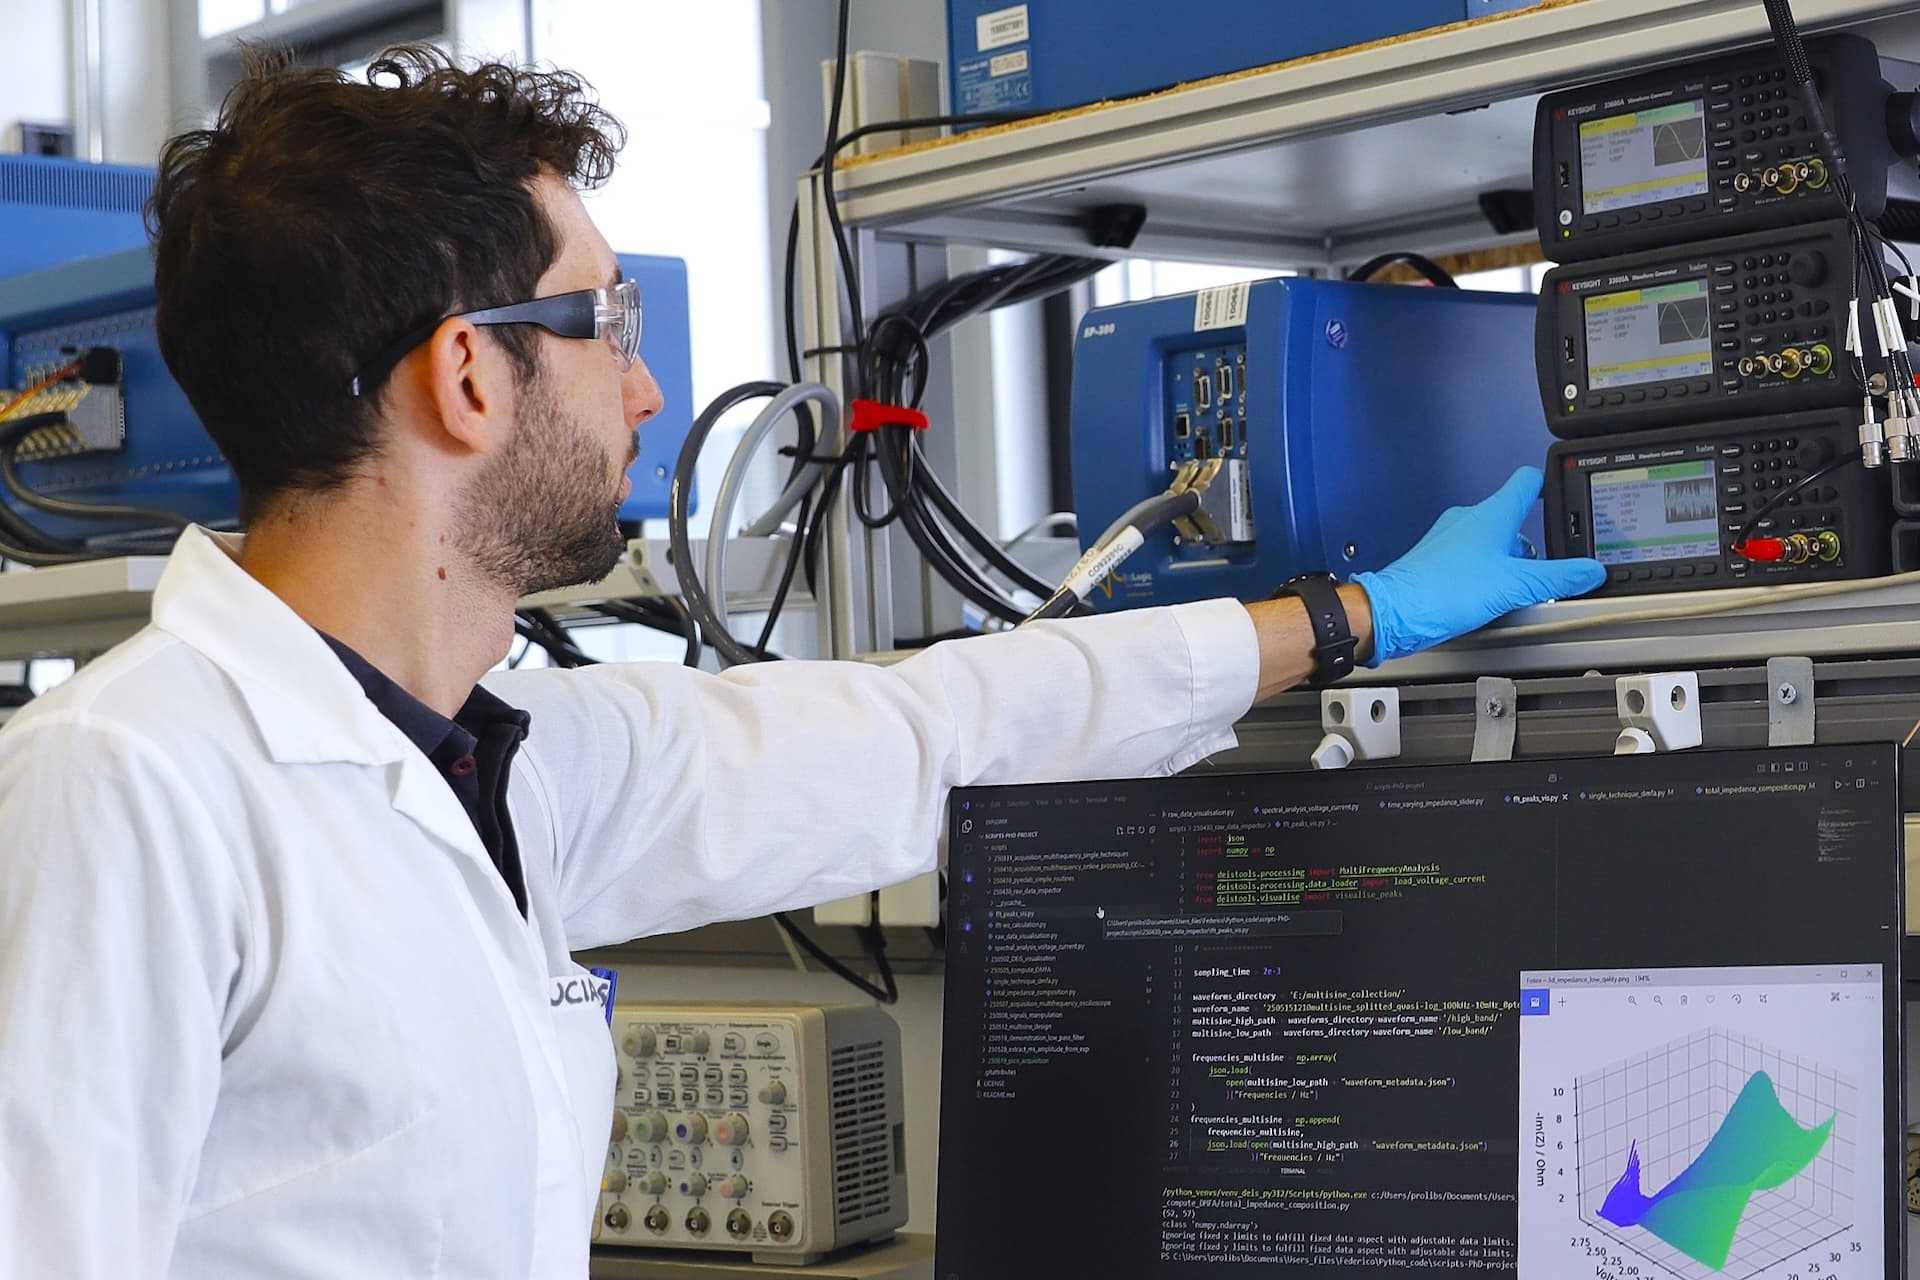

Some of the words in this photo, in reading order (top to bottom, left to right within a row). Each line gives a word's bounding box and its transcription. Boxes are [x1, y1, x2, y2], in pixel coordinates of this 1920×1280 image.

[1568, 104, 1596, 116] KEYSIGHT
[1572, 279, 1601, 290] KEYSIGHT
[1578, 456, 1607, 466] KEYSIGHT
[1227, 834, 1244, 844] json
[1226, 847, 1248, 856] numpy
[1218, 869, 1305, 878] deistools.processing
[1394, 875, 1486, 886] load_voltage_current
[1217, 894, 1300, 904] deistools.visualise
[1336, 890, 1402, 900] visualise_peaks
[1194, 968, 1250, 978] sampling_time
[1193, 992, 1276, 1002] waveforms_directory
[1193, 1004, 1250, 1014] waveform_name
[1192, 1016, 1276, 1026] multisine_high_path
[1192, 1028, 1271, 1038] multisine_low_path
[1192, 1054, 1284, 1063] frequencies_multisine
[1553, 1088, 1564, 1096] 10
[1190, 1115, 1282, 1125] frequencies_multisine
[1556, 1115, 1562, 1124] 8
[1208, 1128, 1304, 1138] frequencies_multisine,
[1536, 1112, 1545, 1149] -Im(Z)
[1557, 1142, 1564, 1150] 6
[1536, 1159, 1546, 1187] Ohm
[1558, 1168, 1564, 1176] 4
[1558, 1194, 1564, 1203] 2
[1162, 1210, 1178, 1218] (52,
[1182, 1210, 1196, 1218] 57)
[1192, 1220, 1258, 1230] 'numpy.ndarray'>
[1162, 1232, 1196, 1240] Ignoring
[1200, 1232, 1220, 1240] fixed
[1234, 1232, 1258, 1240] limits
[1276, 1233, 1305, 1242] fulfill
[1310, 1234, 1331, 1242] fixed
[1335, 1235, 1354, 1243] data
[1357, 1236, 1384, 1244] aspect
[1388, 1236, 1406, 1244] with
[1410, 1236, 1456, 1246] adjustable
[1482, 1238, 1514, 1246] limits.
[1570, 1238, 1590, 1247] 2.75
[1162, 1242, 1195, 1252] Ignoring
[1199, 1243, 1220, 1251] fixed
[1233, 1243, 1258, 1252] limits
[1275, 1244, 1304, 1253] fulfill
[1310, 1244, 1331, 1253] fixed
[1334, 1246, 1353, 1254] data
[1357, 1247, 1383, 1256] aspect
[1388, 1246, 1406, 1255] with
[1410, 1247, 1456, 1256] adjustable
[1482, 1248, 1514, 1258] limits.
[1586, 1248, 1606, 1256] 2.50
[1850, 1242, 1862, 1252] 35
[1602, 1256, 1622, 1266] 2.25
[1830, 1253, 1841, 1262] 30
[1618, 1266, 1639, 1276] 2.00
[1808, 1263, 1820, 1272] 25
